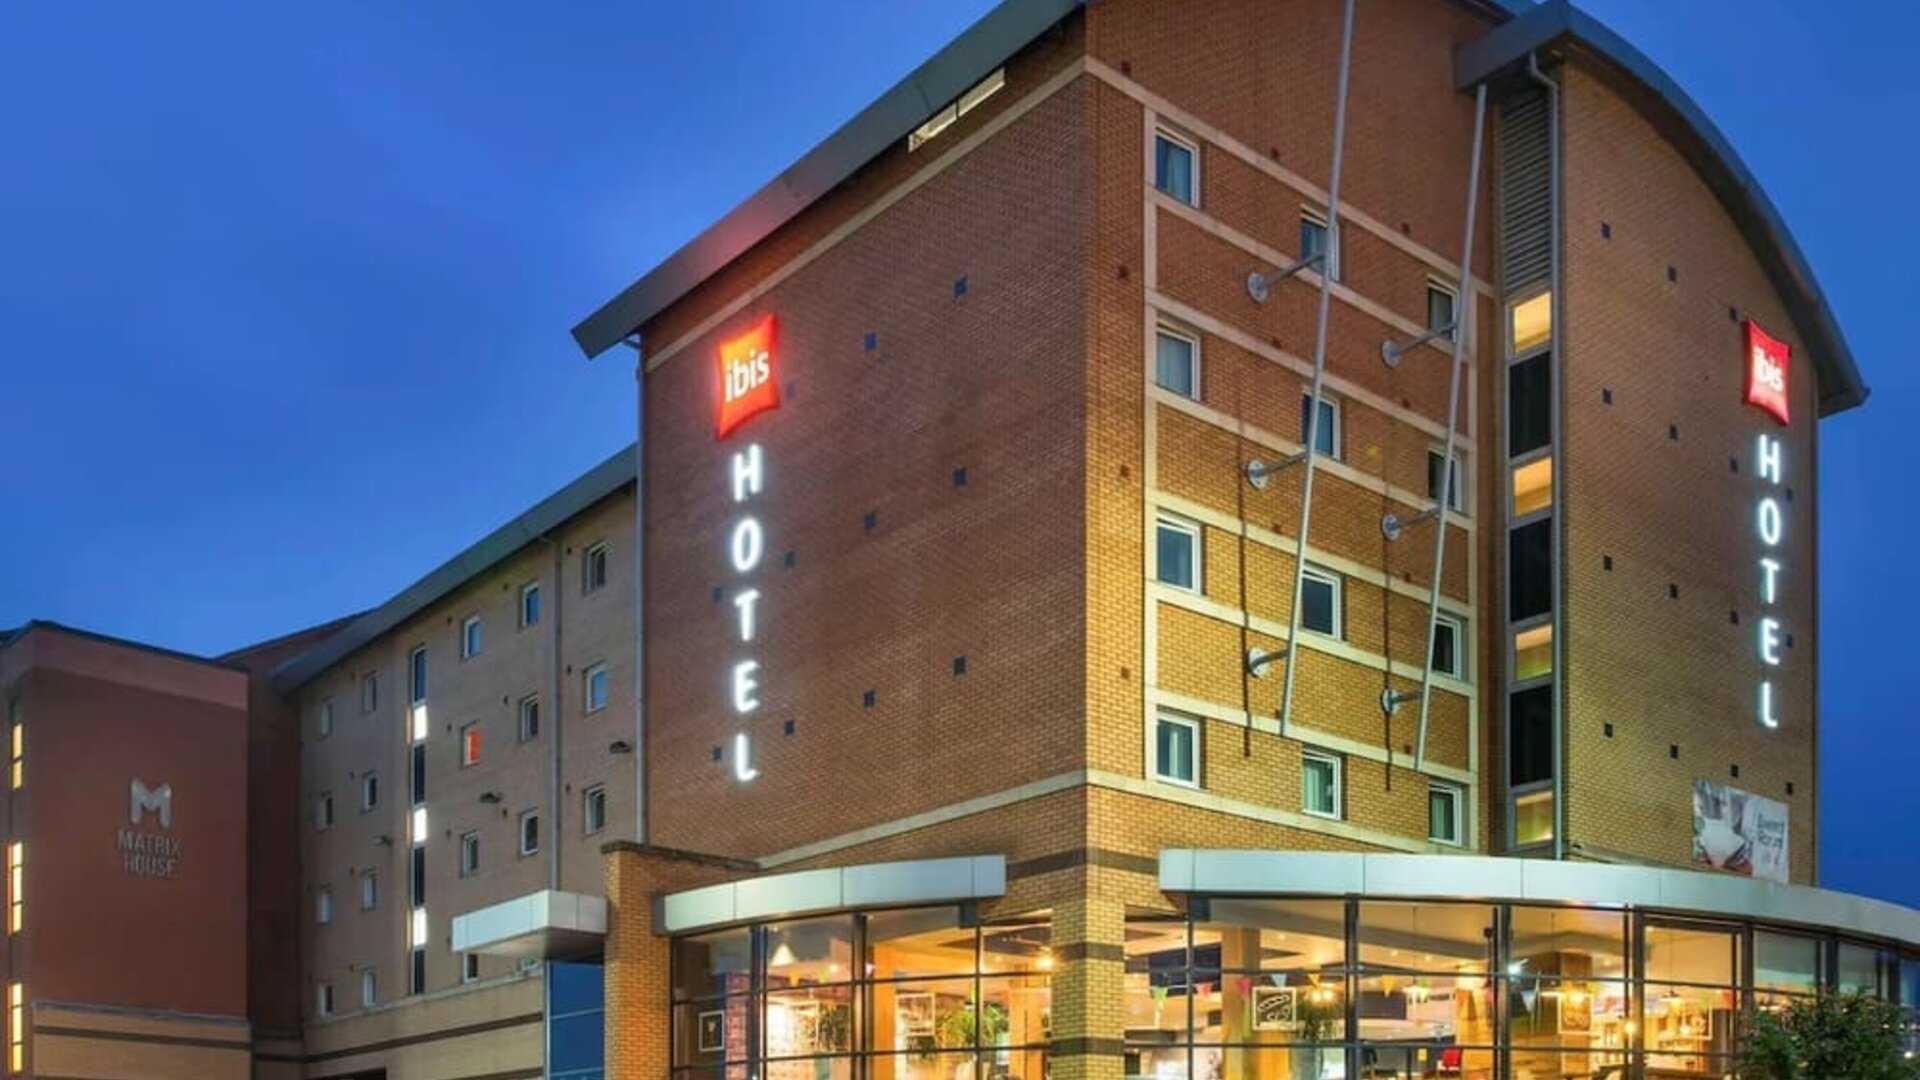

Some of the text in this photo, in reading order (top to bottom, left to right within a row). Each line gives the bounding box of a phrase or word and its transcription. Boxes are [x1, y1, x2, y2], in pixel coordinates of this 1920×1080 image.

[725, 347, 769, 403] ibis
[1753, 345, 1783, 392] ibis
[1758, 433, 1781, 729] HOTEL
[732, 443, 764, 782] HOTEL
[118, 828, 182, 857] MATRIX
[124, 852, 177, 879] HOUSE
